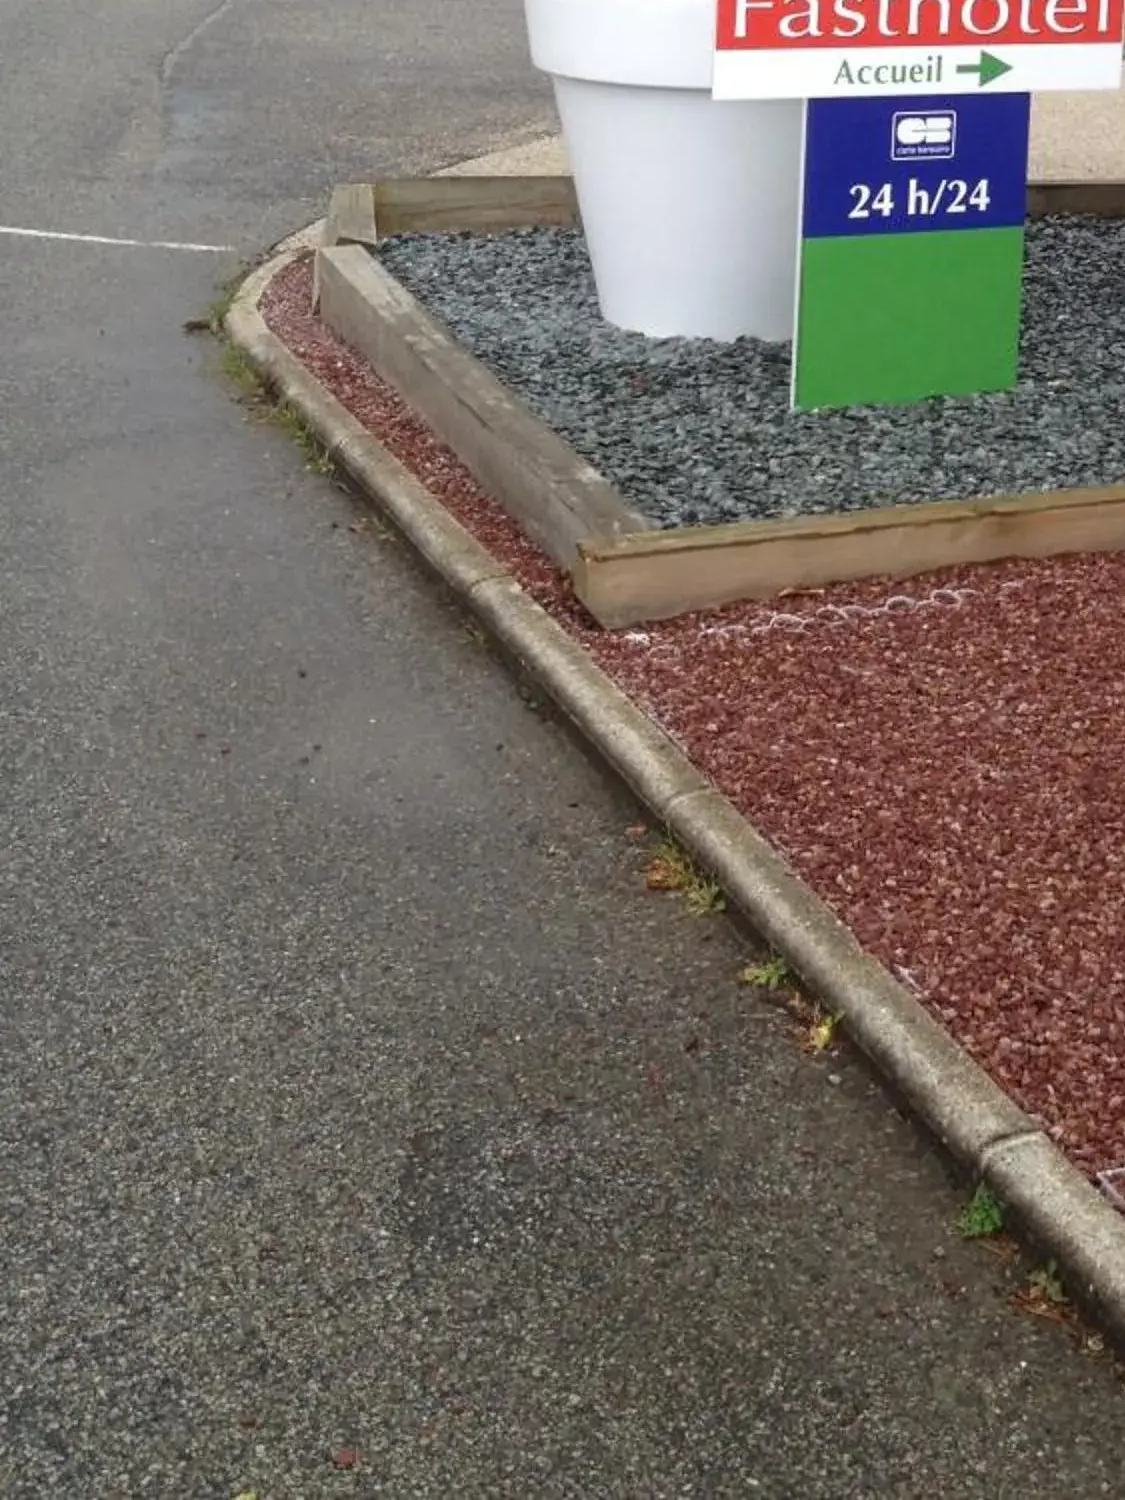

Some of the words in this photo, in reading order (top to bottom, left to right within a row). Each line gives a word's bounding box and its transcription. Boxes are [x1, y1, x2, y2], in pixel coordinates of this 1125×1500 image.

[833, 55, 943, 85] Accueil
[847, 183, 895, 219] 24
[907, 178, 991, 215] h/24
